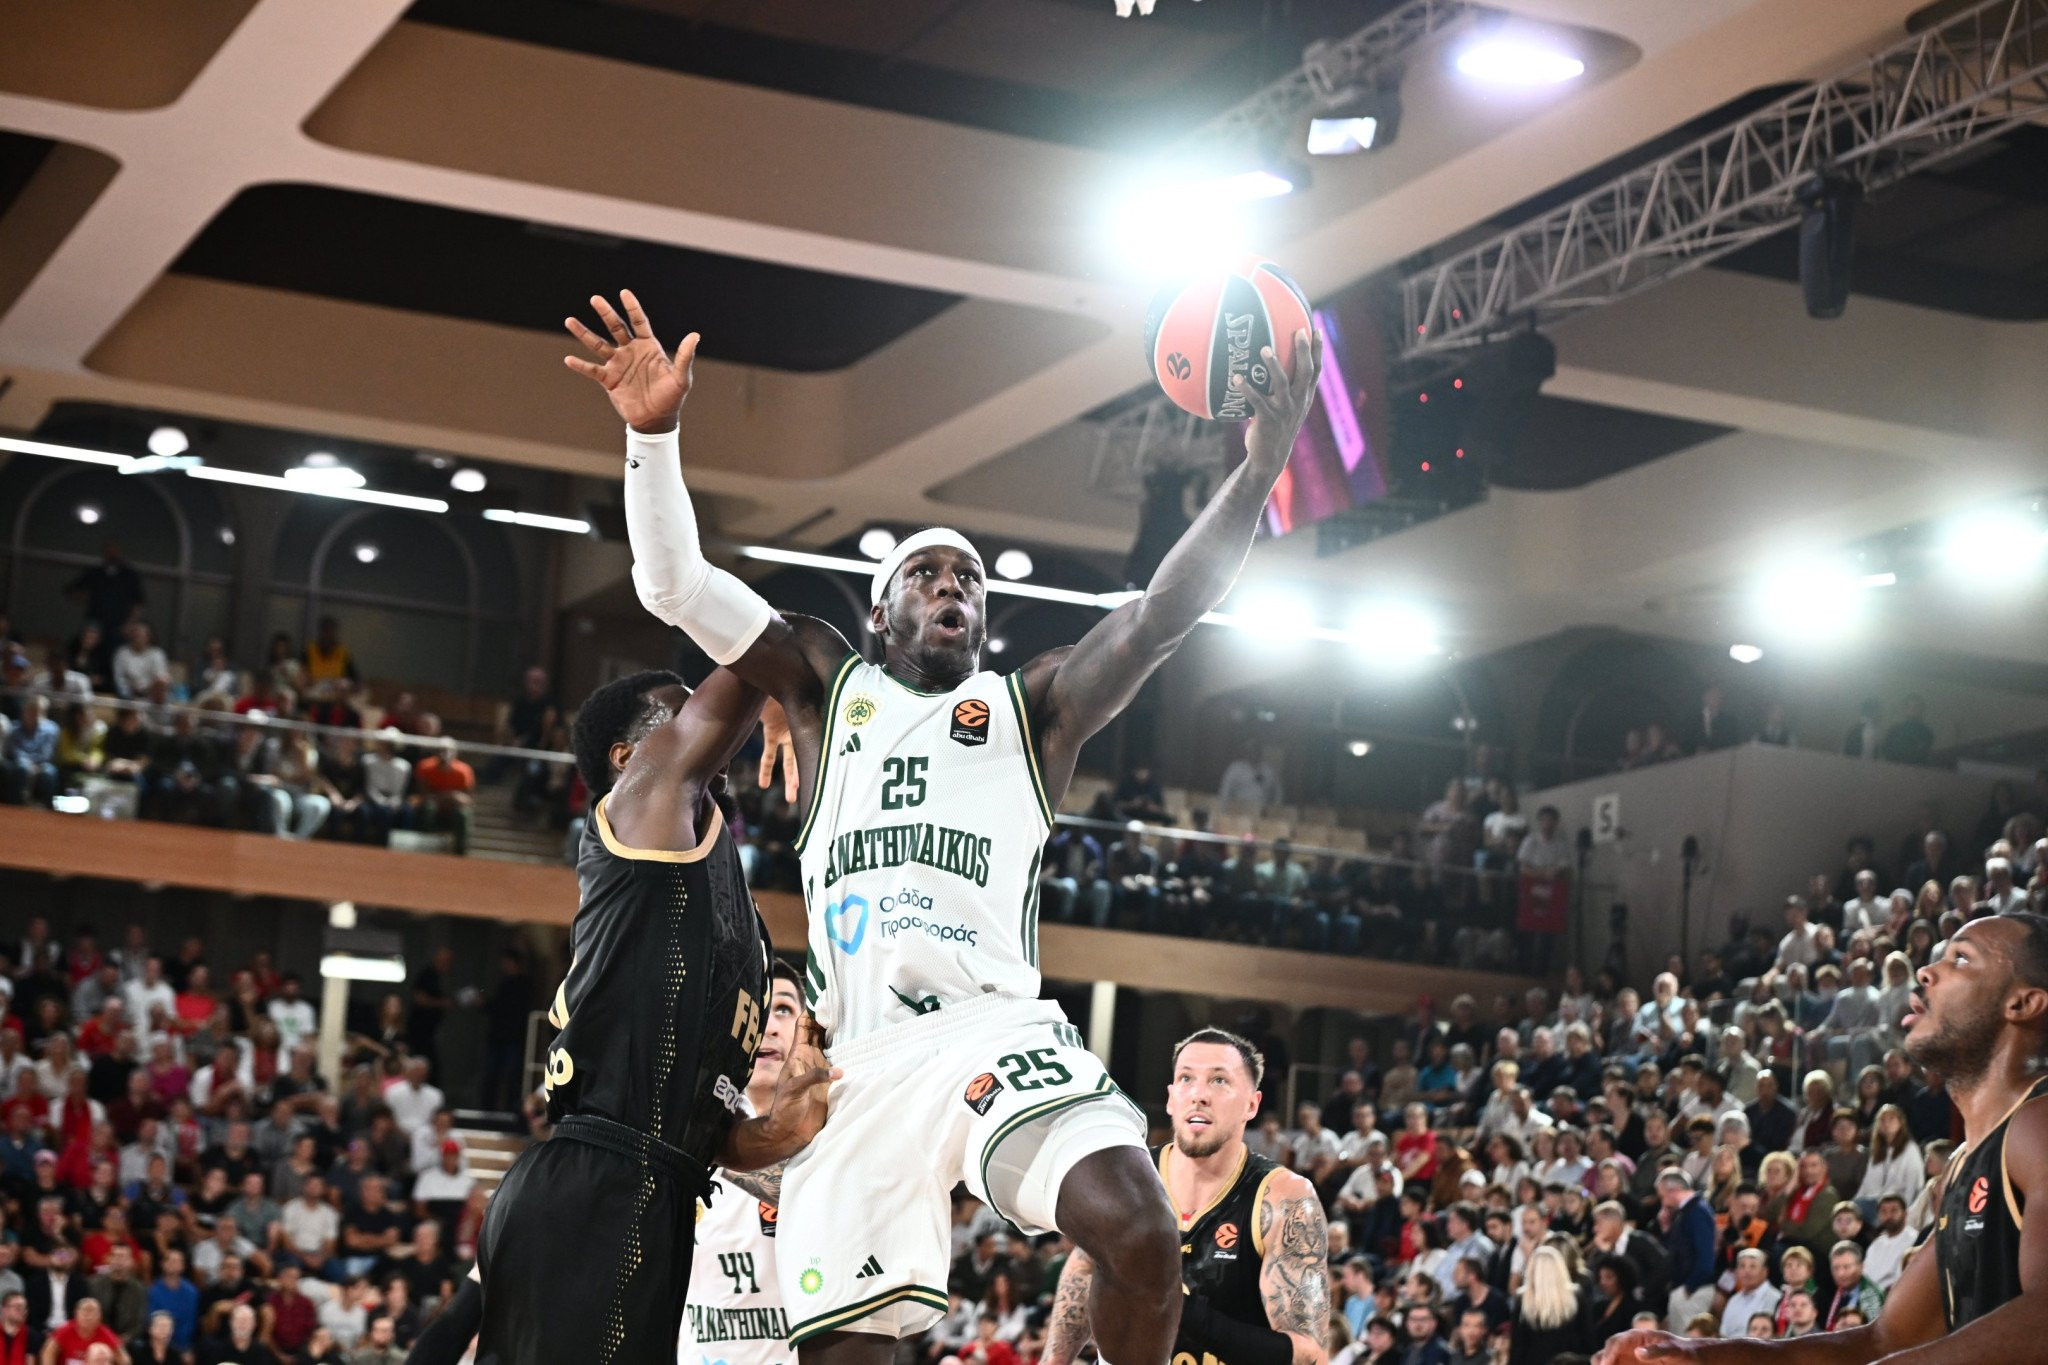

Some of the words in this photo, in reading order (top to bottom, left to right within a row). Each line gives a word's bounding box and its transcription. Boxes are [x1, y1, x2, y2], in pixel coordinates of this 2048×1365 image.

[881, 756, 929, 810] 25
[823, 822, 992, 889] ANATHINAIKOS
[879, 888, 933, 913] Οάδα
[996, 1047, 1074, 1092] 25
[718, 1251, 761, 1294] 44
